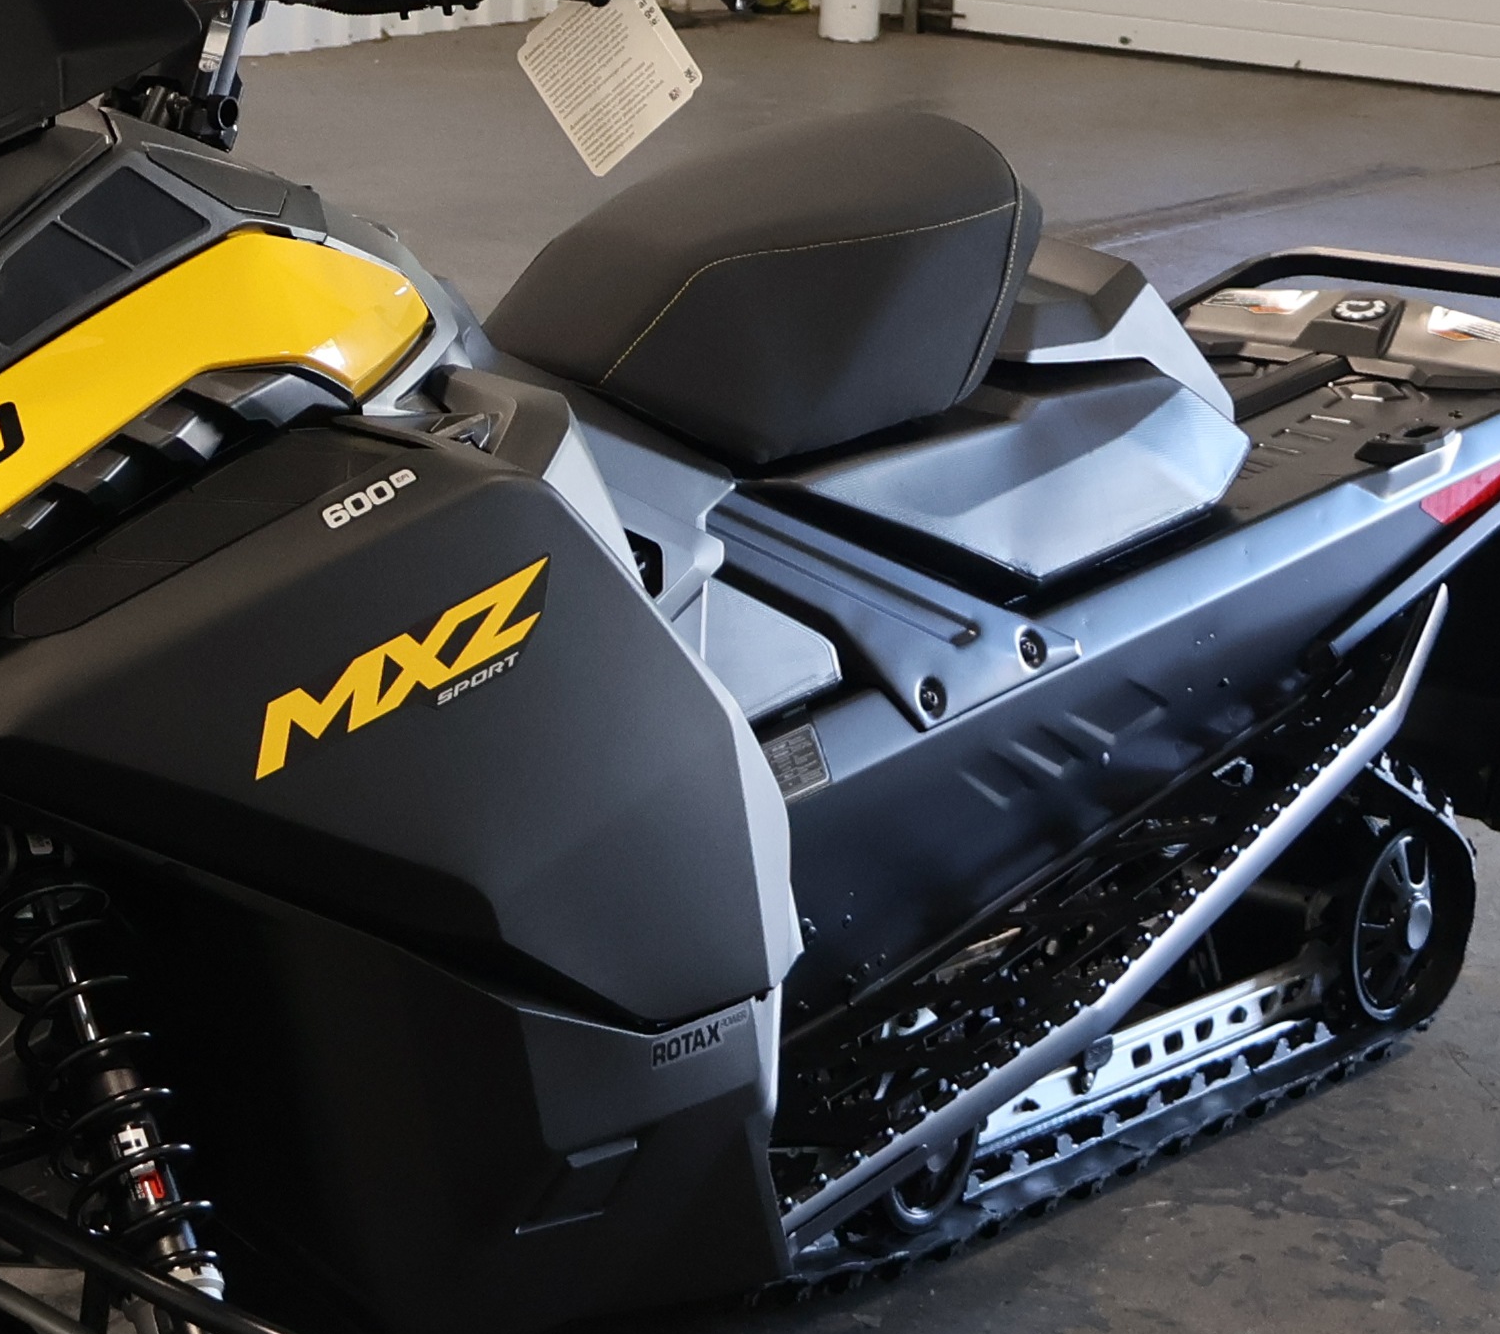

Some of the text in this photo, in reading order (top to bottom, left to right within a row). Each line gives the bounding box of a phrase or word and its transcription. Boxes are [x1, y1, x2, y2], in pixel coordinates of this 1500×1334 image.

[322, 480, 395, 529] 600
[256, 557, 549, 780] MXZ
[437, 651, 519, 706] SPORT
[652, 1020, 721, 1067] ROTAX
